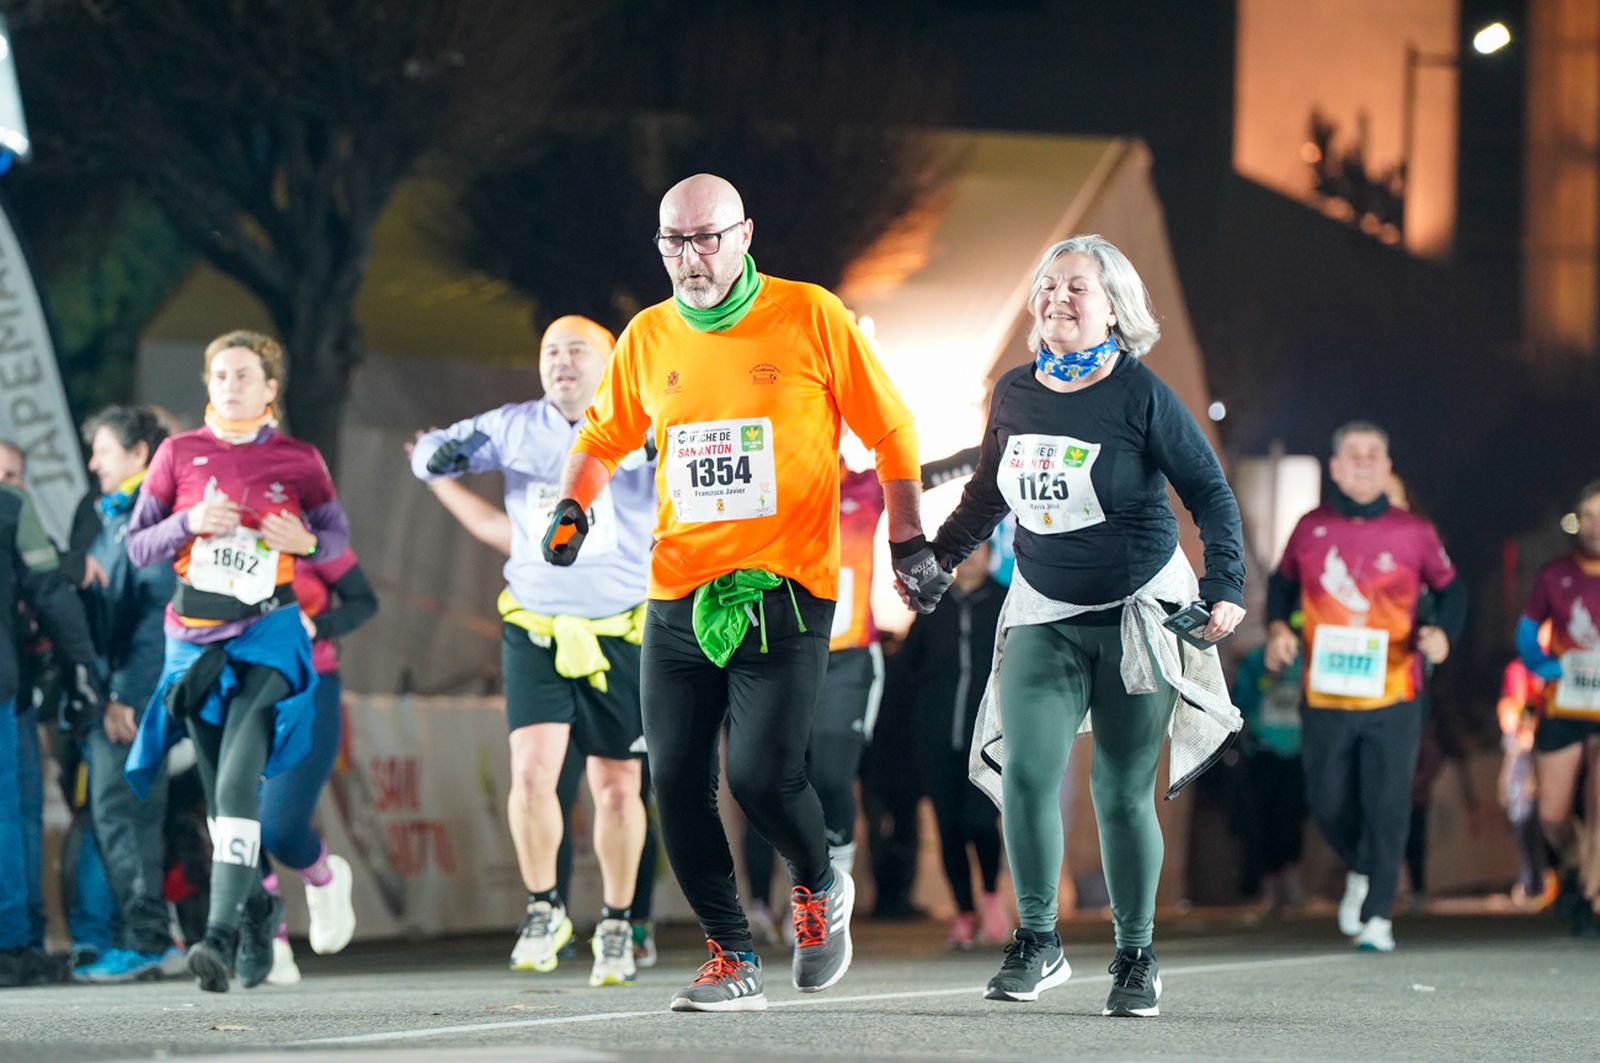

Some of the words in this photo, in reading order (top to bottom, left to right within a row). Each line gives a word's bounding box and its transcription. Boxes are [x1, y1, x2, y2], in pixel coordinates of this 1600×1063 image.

[719, 431, 731, 442] DE
[677, 447, 697, 459] SAN
[698, 441, 733, 456] ANTÓN
[686, 455, 753, 488] 1354
[695, 489, 725, 497] Francisco
[725, 487, 746, 495] Javier
[1017, 471, 1069, 501] 1125
[213, 547, 259, 576] 1862
